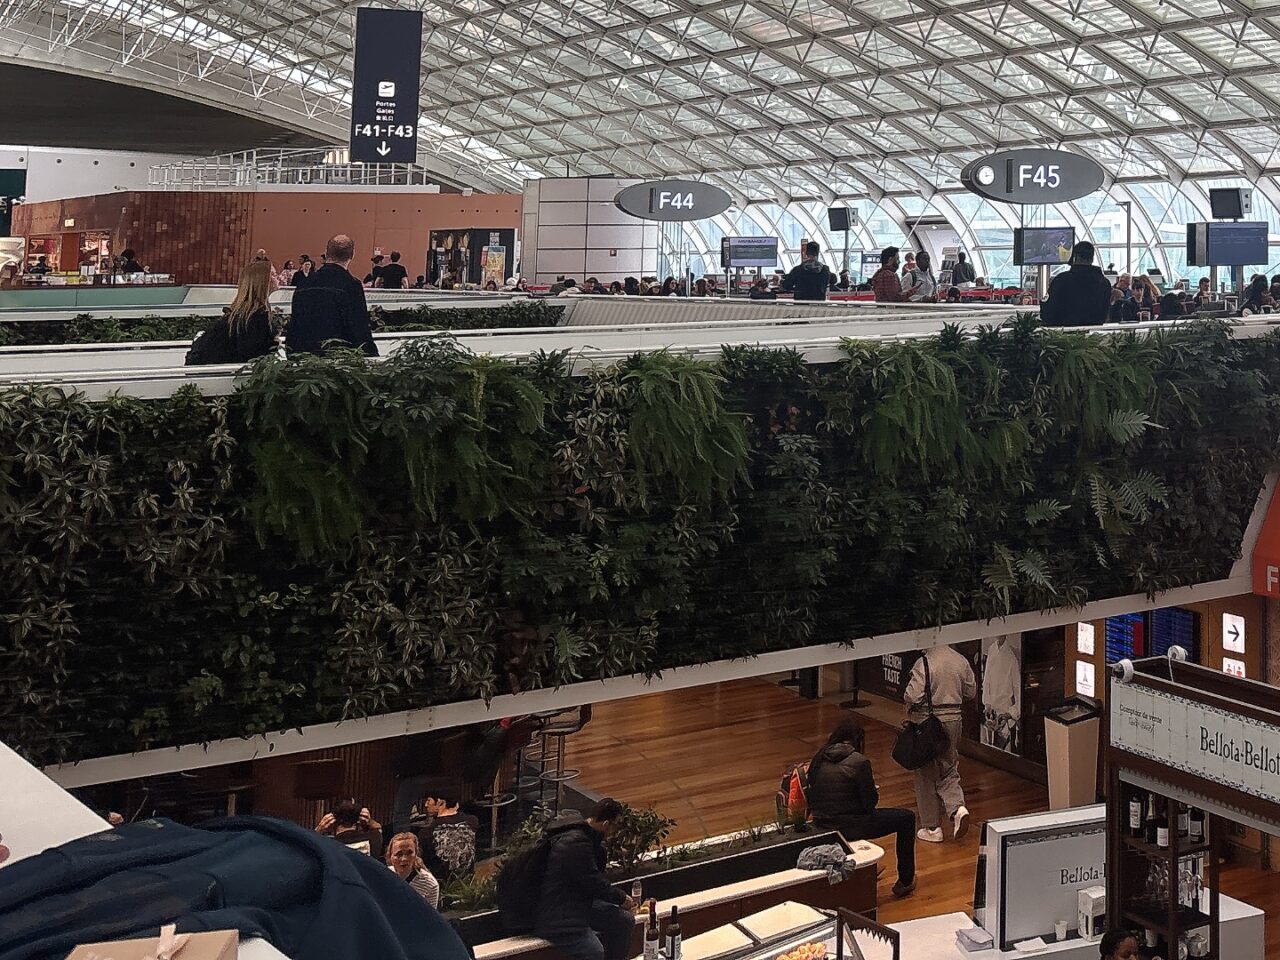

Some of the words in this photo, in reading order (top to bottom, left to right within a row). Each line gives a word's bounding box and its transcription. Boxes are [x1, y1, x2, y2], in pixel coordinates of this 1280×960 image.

[355, 124, 413, 138] F41-F43
[1019, 165, 1060, 188] F45
[659, 192, 694, 209] F44
[883, 667, 901, 685] TASTE
